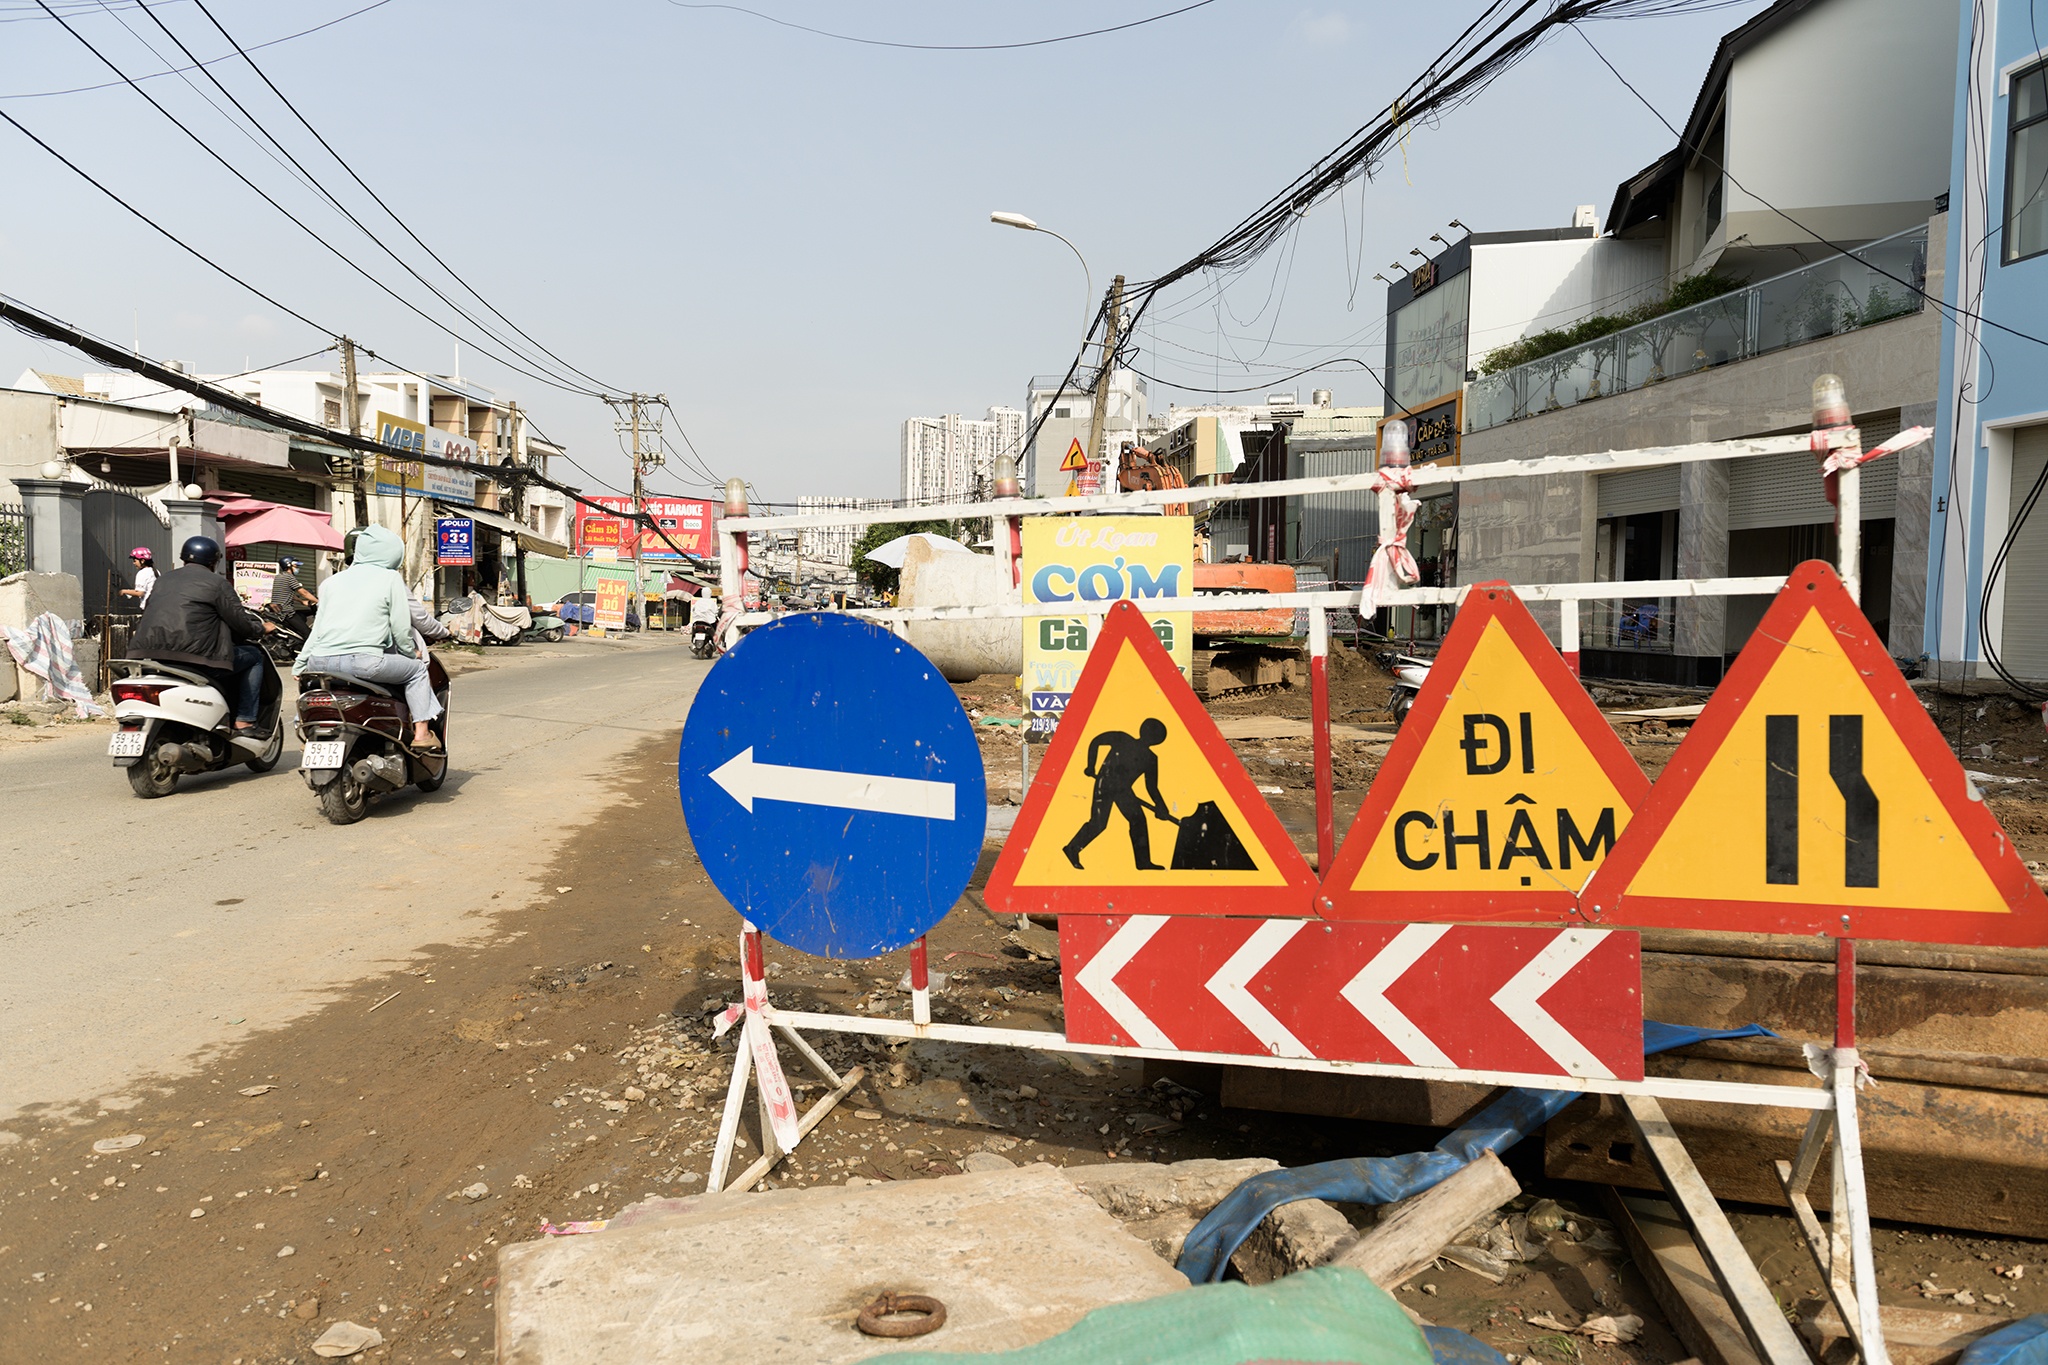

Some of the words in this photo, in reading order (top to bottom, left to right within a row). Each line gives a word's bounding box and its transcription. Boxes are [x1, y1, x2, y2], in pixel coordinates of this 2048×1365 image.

[380, 422, 424, 454] MPE
[1169, 423, 1192, 450] ABC
[664, 504, 703, 516] KARAOKE
[441, 532, 468, 544] 933
[1055, 522, 1091, 547] Út
[1091, 525, 1158, 550] Loan
[1032, 556, 1182, 602] CƠM
[598, 580, 626, 596] CẦM
[602, 596, 619, 610] ĐỒ
[1039, 618, 1088, 651] Cà
[185, 698, 213, 706] LEAD
[114, 733, 141, 744] 59-X2
[1460, 712, 1535, 775] ĐI
[111, 744, 142, 755] 160.18
[310, 744, 339, 754] 59-T2
[304, 755, 339, 766] 047.91
[1394, 793, 1617, 886] CHẬM
